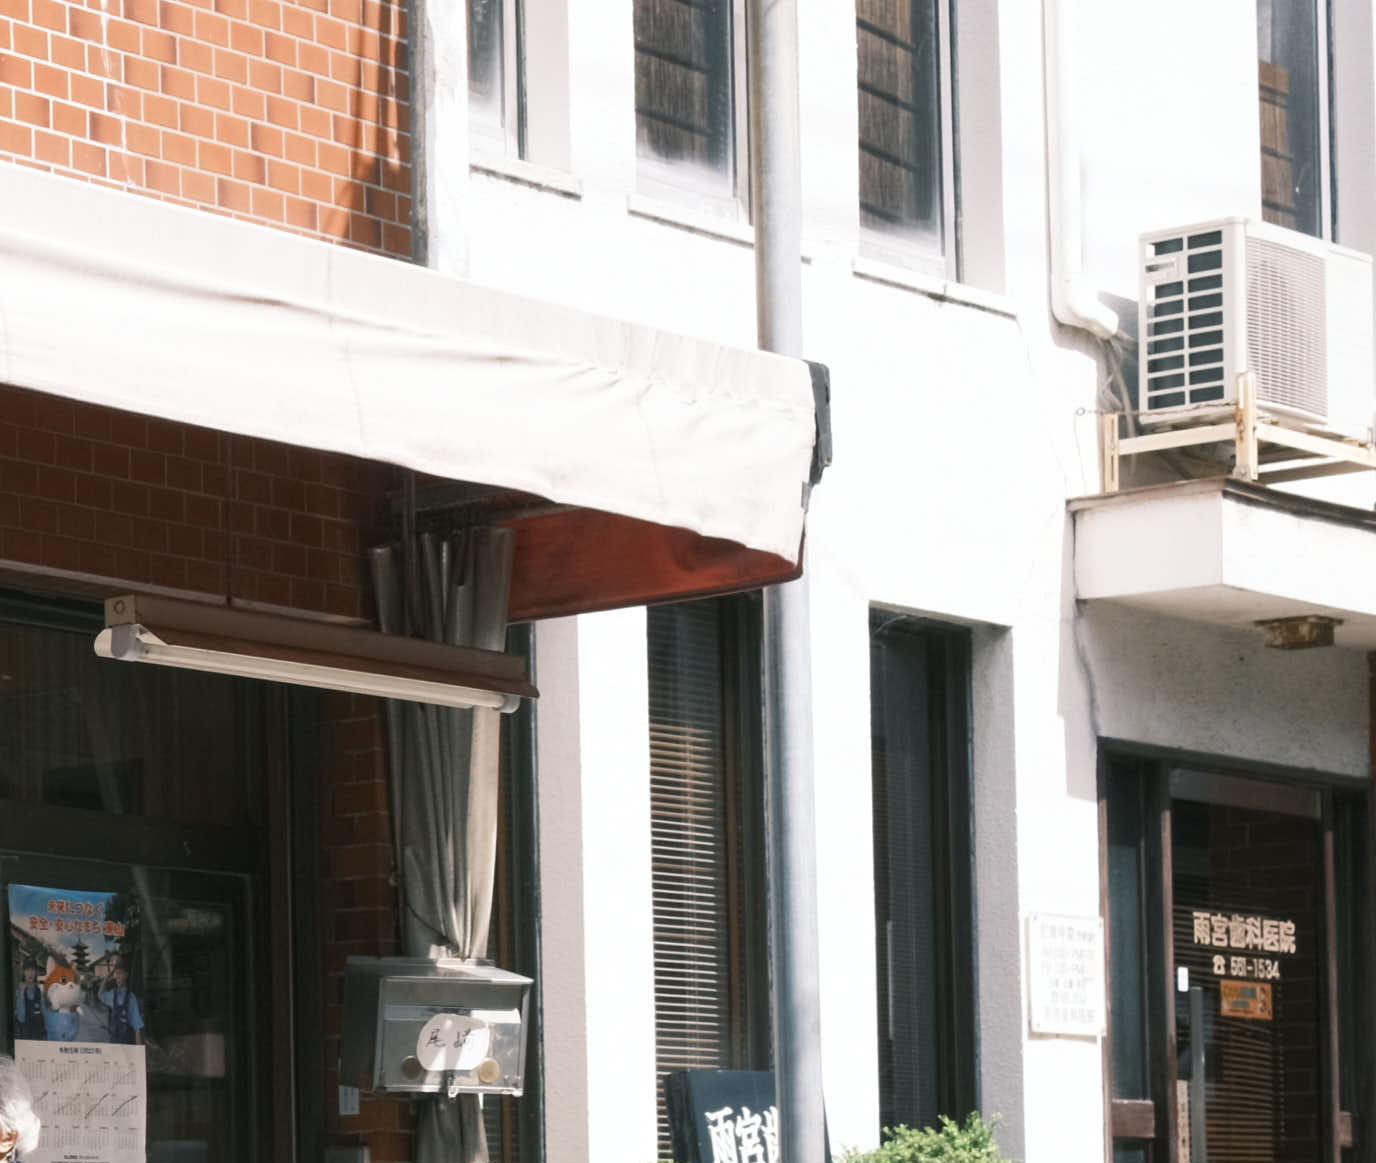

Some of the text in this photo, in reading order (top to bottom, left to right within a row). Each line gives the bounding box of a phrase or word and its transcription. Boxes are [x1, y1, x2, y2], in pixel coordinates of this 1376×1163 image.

[1192, 911, 1296, 954] 雨宮歯科医院
